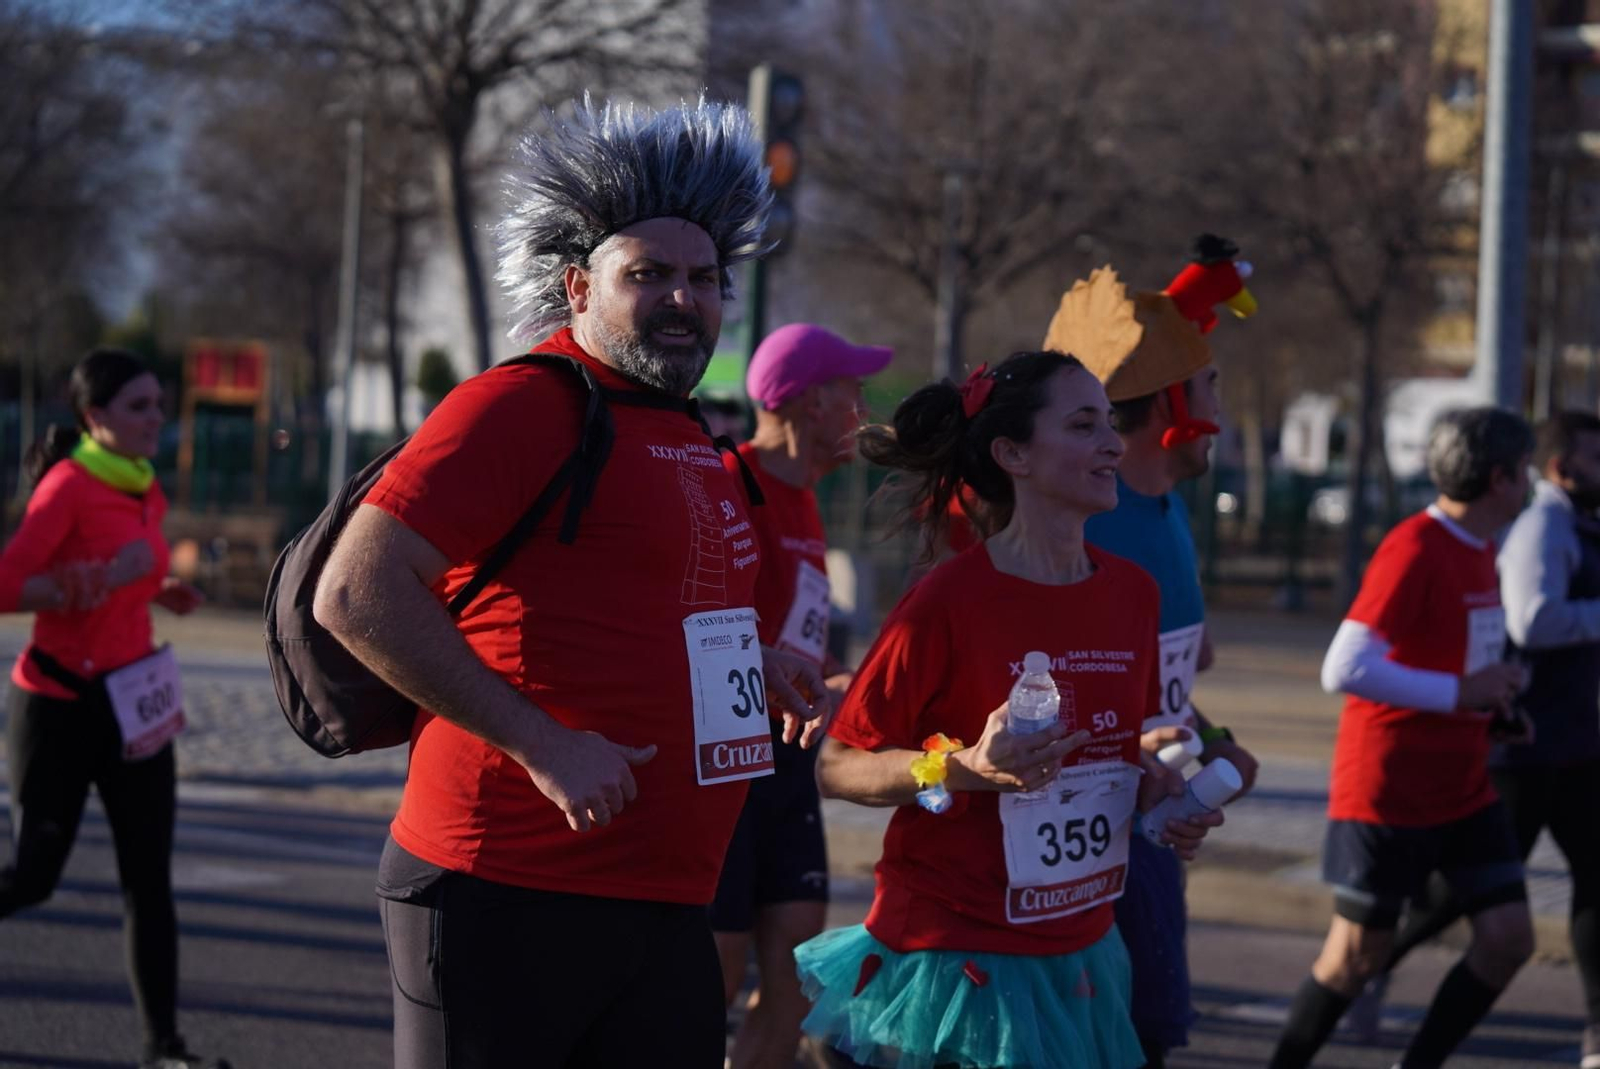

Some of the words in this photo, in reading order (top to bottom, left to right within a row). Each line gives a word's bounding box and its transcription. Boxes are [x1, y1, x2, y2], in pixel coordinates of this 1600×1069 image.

[646, 444, 689, 462] XXXVII
[720, 499, 736, 520] 50
[1068, 650, 1089, 660] SAN
[1090, 650, 1135, 660] SILVESTRE
[1069, 663, 1127, 672] CORDOBESA
[1092, 710, 1118, 732] 50
[1037, 814, 1111, 867] 359
[1019, 876, 1107, 911] Cruzcampo
